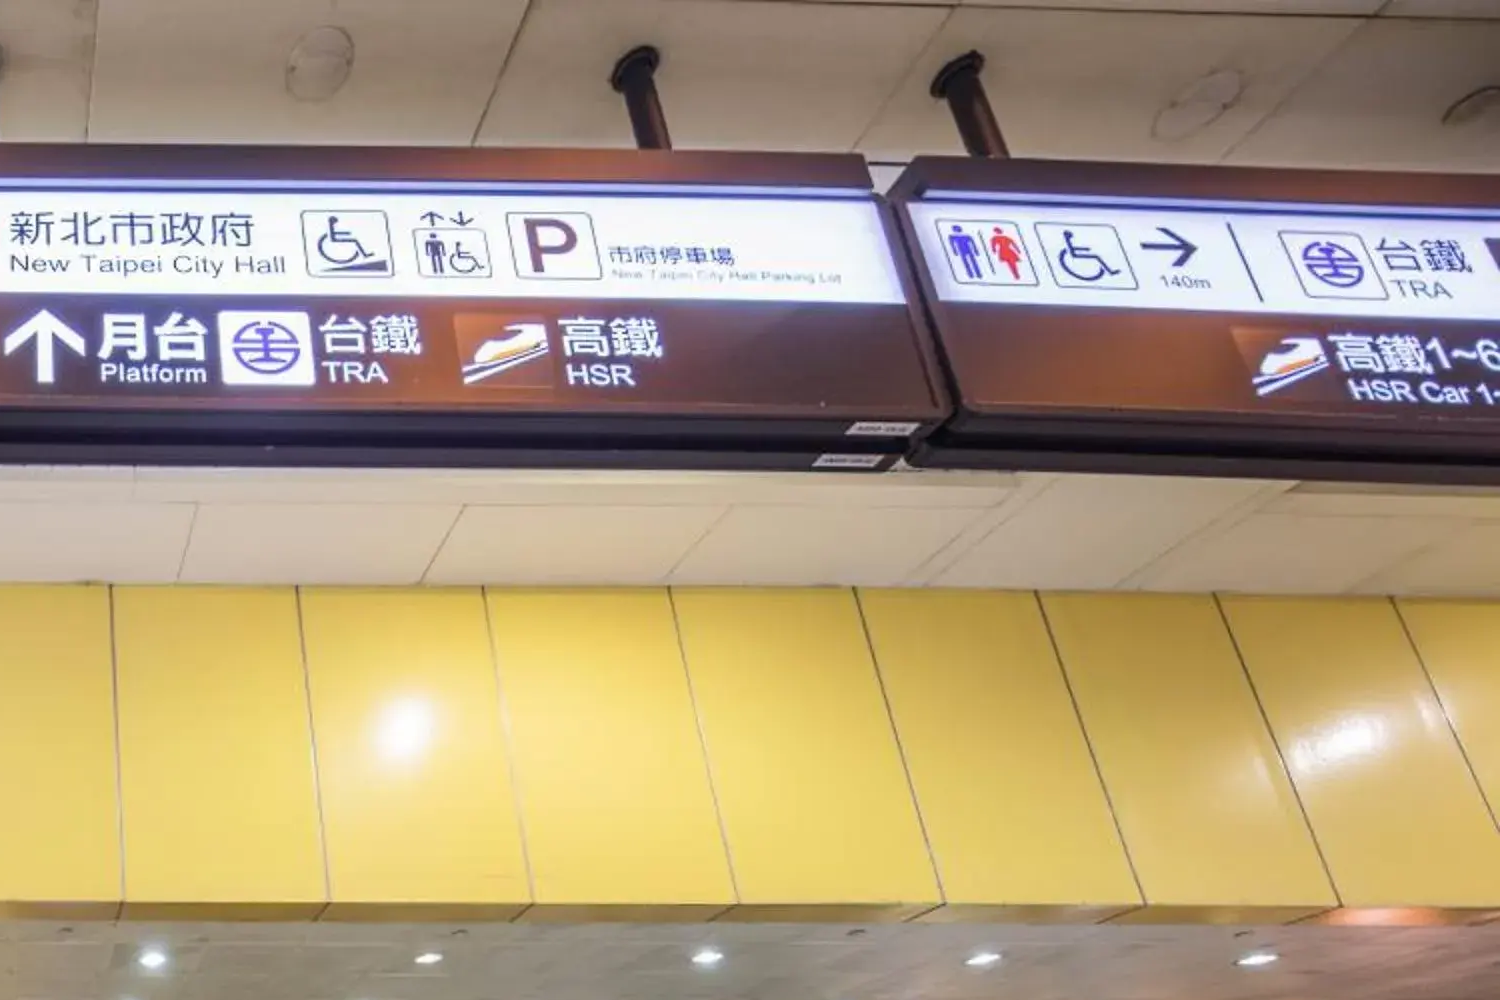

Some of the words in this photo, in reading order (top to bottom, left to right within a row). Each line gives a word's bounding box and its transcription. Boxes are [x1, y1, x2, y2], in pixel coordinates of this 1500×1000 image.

[9, 211, 255, 248] 新北市政府
[10, 255, 71, 274] New
[80, 255, 163, 278] Taipei
[173, 255, 223, 279] City
[235, 256, 287, 275] Hall
[608, 247, 736, 266] 市府停車場
[1375, 237, 1473, 275] 台鐵
[1159, 275, 1212, 291] 140m
[1388, 279, 1453, 301] TRA
[98, 312, 208, 363] 月台
[318, 313, 423, 357] 台鐵
[557, 316, 665, 359] 高鐵
[100, 362, 207, 384] Platform
[322, 361, 389, 384] TRA
[565, 363, 637, 387] HSR
[1347, 378, 1420, 404] HSR
[1420, 380, 1470, 405] Car
[1476, 383, 1500, 406] 1
